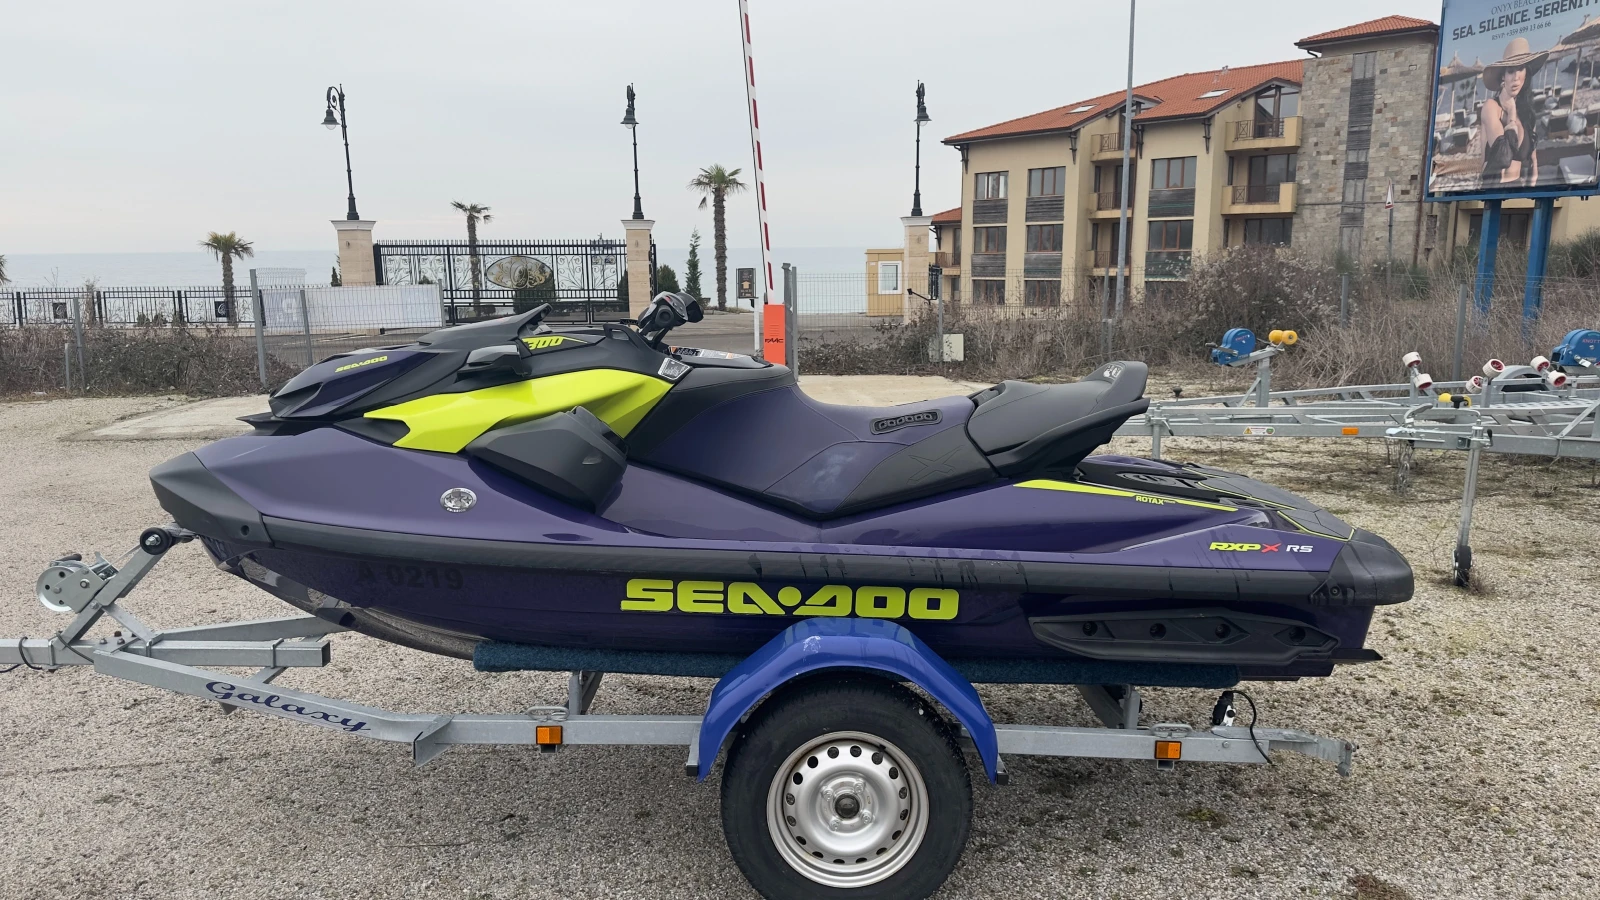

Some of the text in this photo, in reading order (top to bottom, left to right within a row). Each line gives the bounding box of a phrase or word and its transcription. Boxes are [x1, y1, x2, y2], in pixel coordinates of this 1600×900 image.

[1491, 2, 1513, 15] ONYX
[1453, 0, 1598, 41] SEA. SILENCE. SERENI
[527, 336, 564, 350] 300
[1135, 494, 1164, 506] ROTAX
[1286, 544, 1314, 553] RS
[386, 564, 465, 591] 0219
[206, 681, 372, 732] Galaxy
